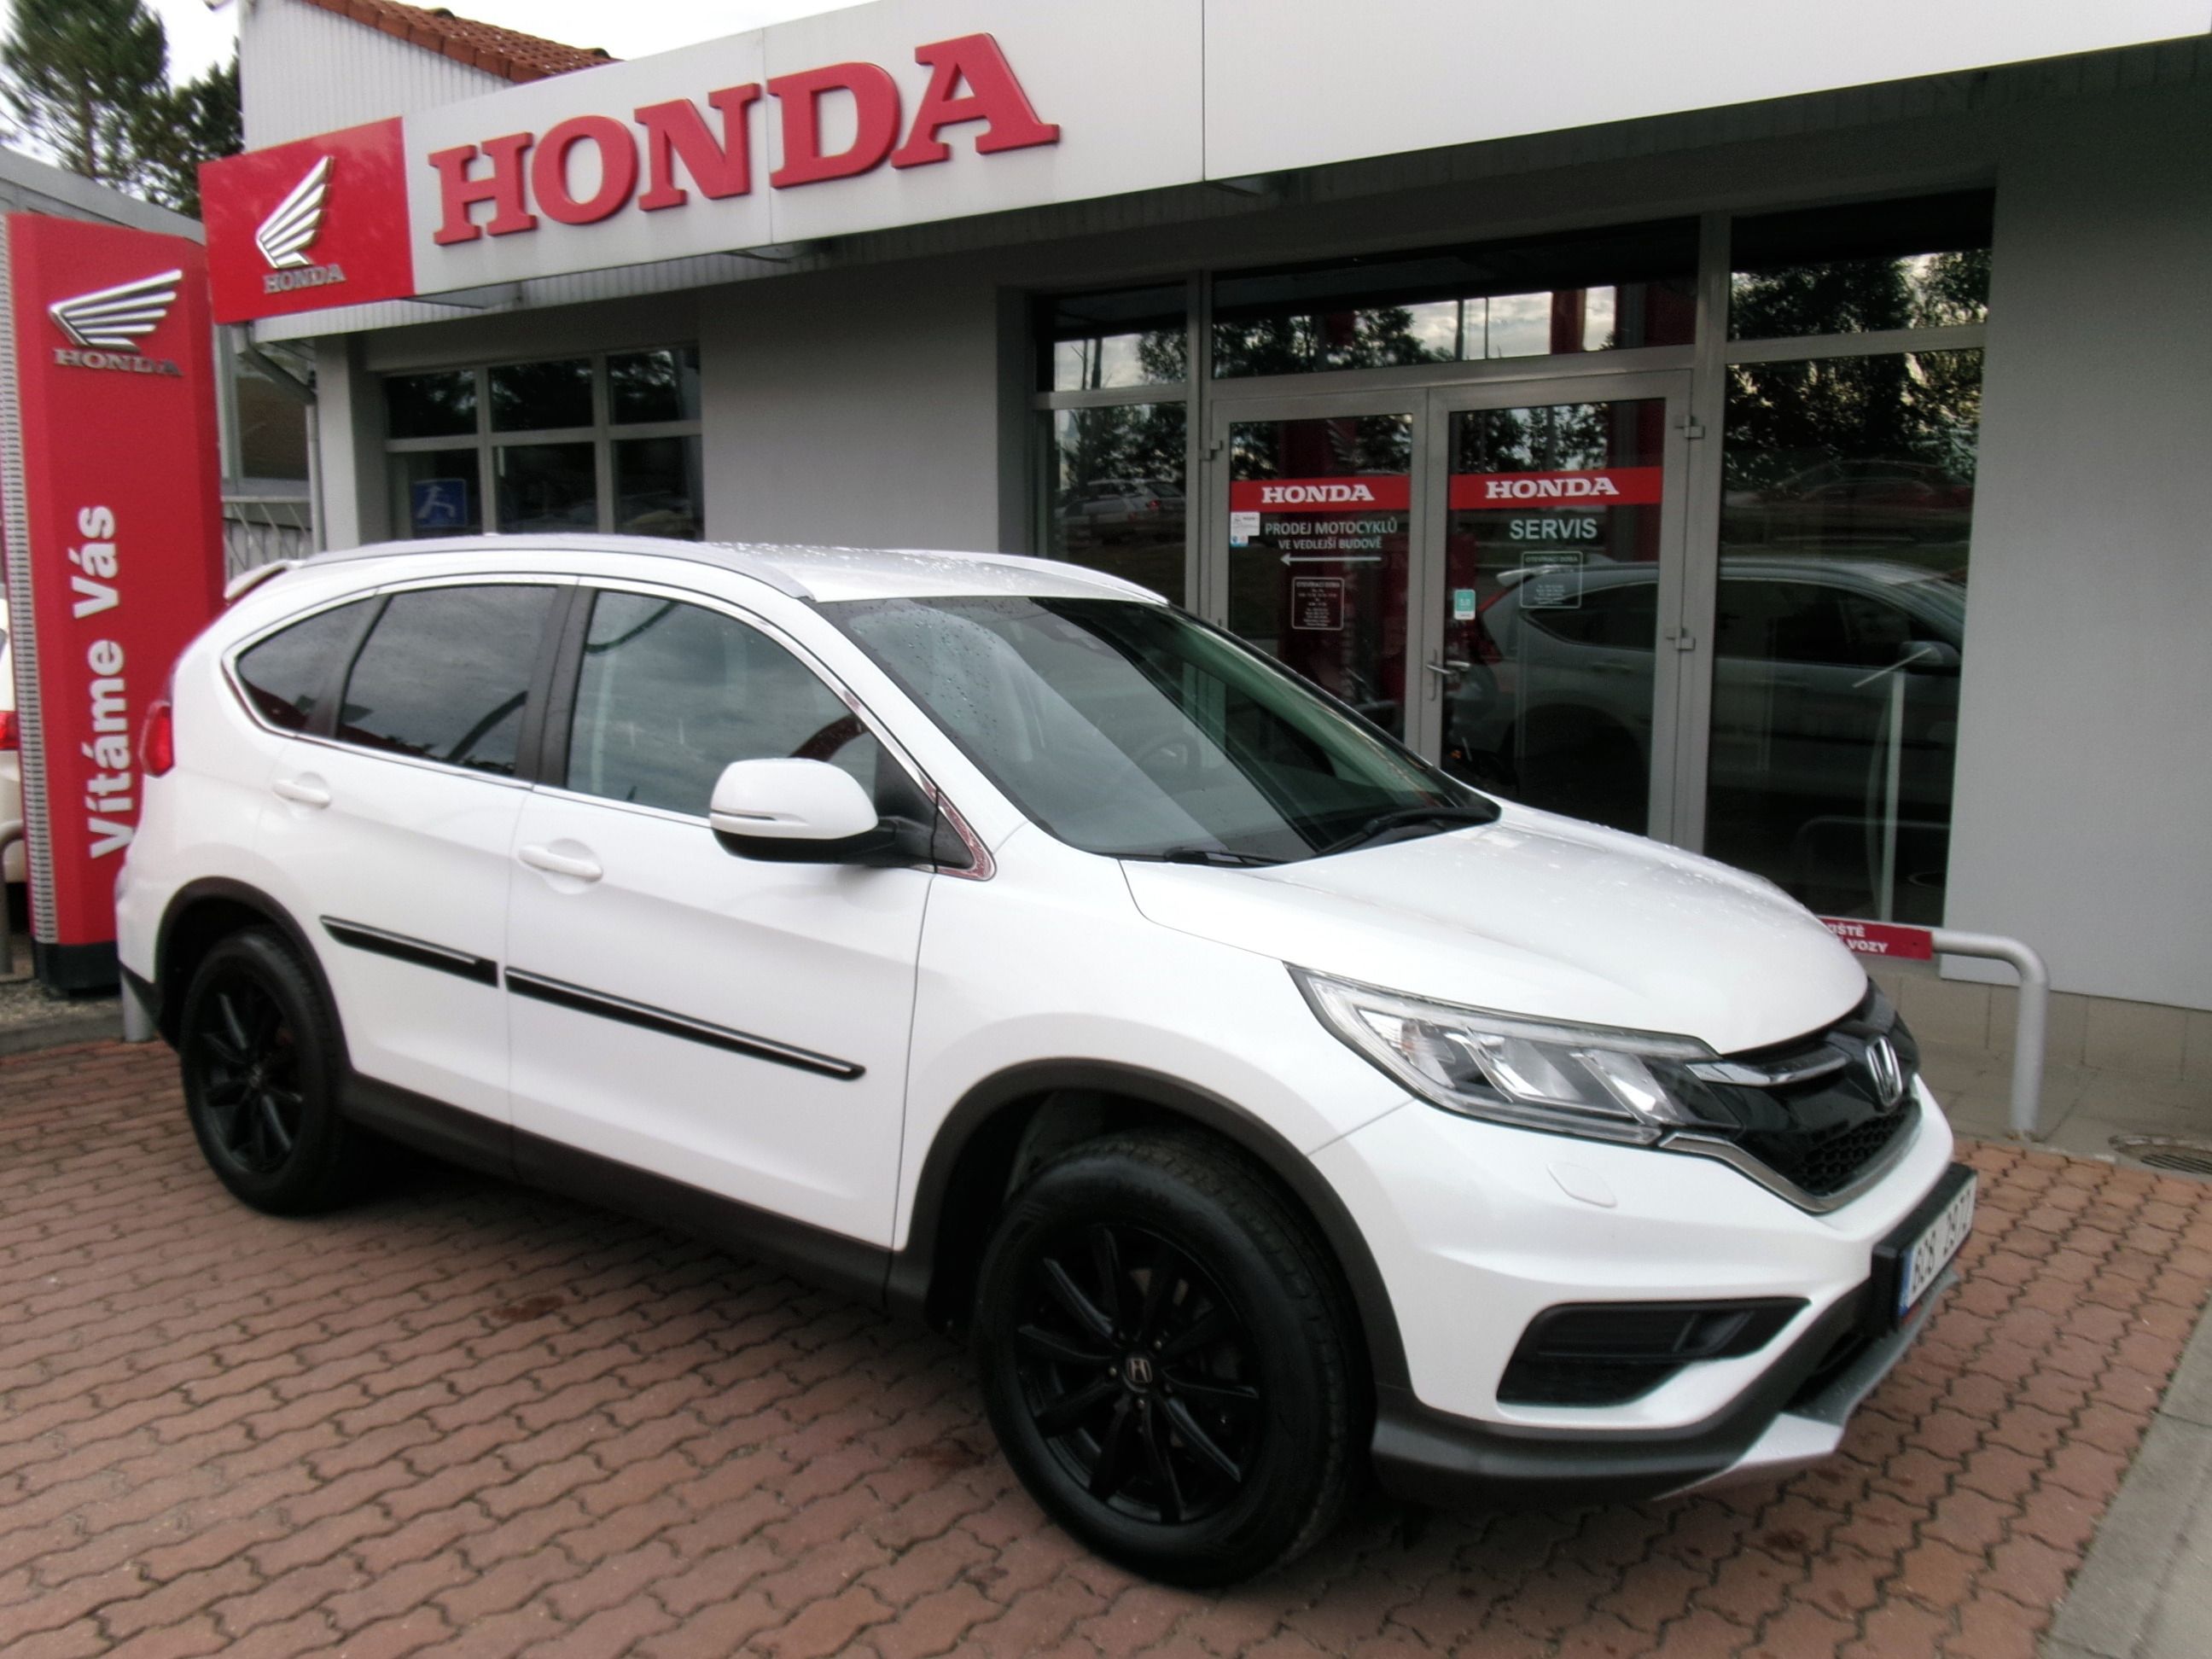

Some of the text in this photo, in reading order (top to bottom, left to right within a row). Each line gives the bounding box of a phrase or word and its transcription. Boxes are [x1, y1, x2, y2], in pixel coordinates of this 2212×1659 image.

[428, 32, 1061, 247] HONDA
[262, 262, 347, 294] HONDA
[53, 347, 184, 376] HONDA
[1260, 484, 1376, 504] HONDA
[1485, 477, 1621, 499] HONDA
[1264, 516, 1398, 535] PRODEJ MOTOCYKLŮ
[1509, 517, 1598, 540] SERVIS
[1278, 539, 1291, 550] VE
[67, 504, 134, 859] Vítáme Vás
[1846, 938, 1889, 953] VOZY
